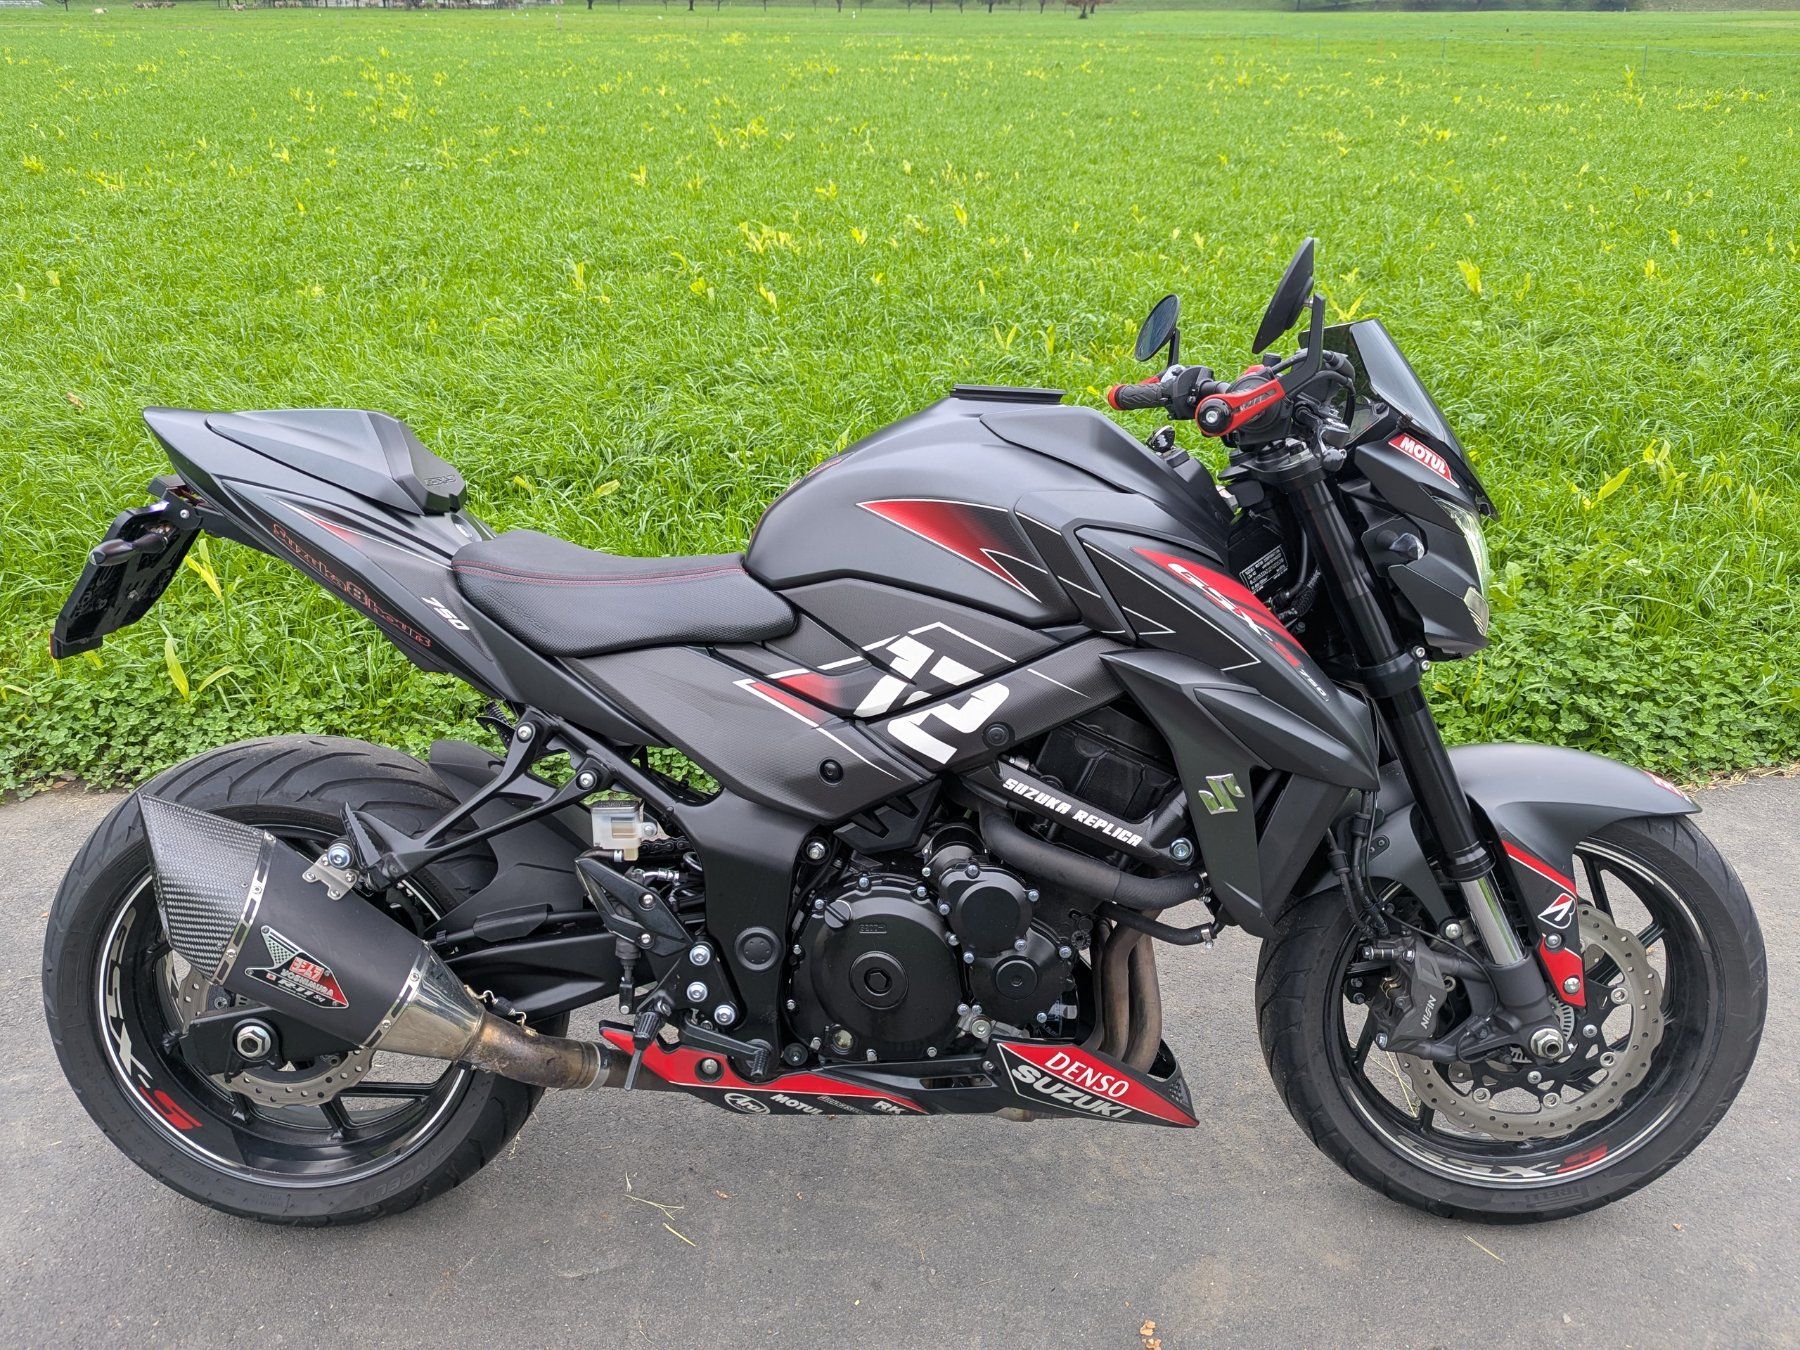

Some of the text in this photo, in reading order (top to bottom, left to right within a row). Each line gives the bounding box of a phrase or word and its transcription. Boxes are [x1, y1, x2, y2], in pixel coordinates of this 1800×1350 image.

[1400, 436, 1446, 475] MOTUL
[421, 597, 471, 631] 750
[1002, 778, 1143, 847] SUZUKA REPLICA
[280, 968, 334, 997] YOSHIMURA
[106, 906, 203, 1130] GSX-S
[1011, 1064, 1133, 1119] SUZUKI
[1044, 1051, 1130, 1098] DENSO
[770, 1093, 824, 1115] MOTUL
